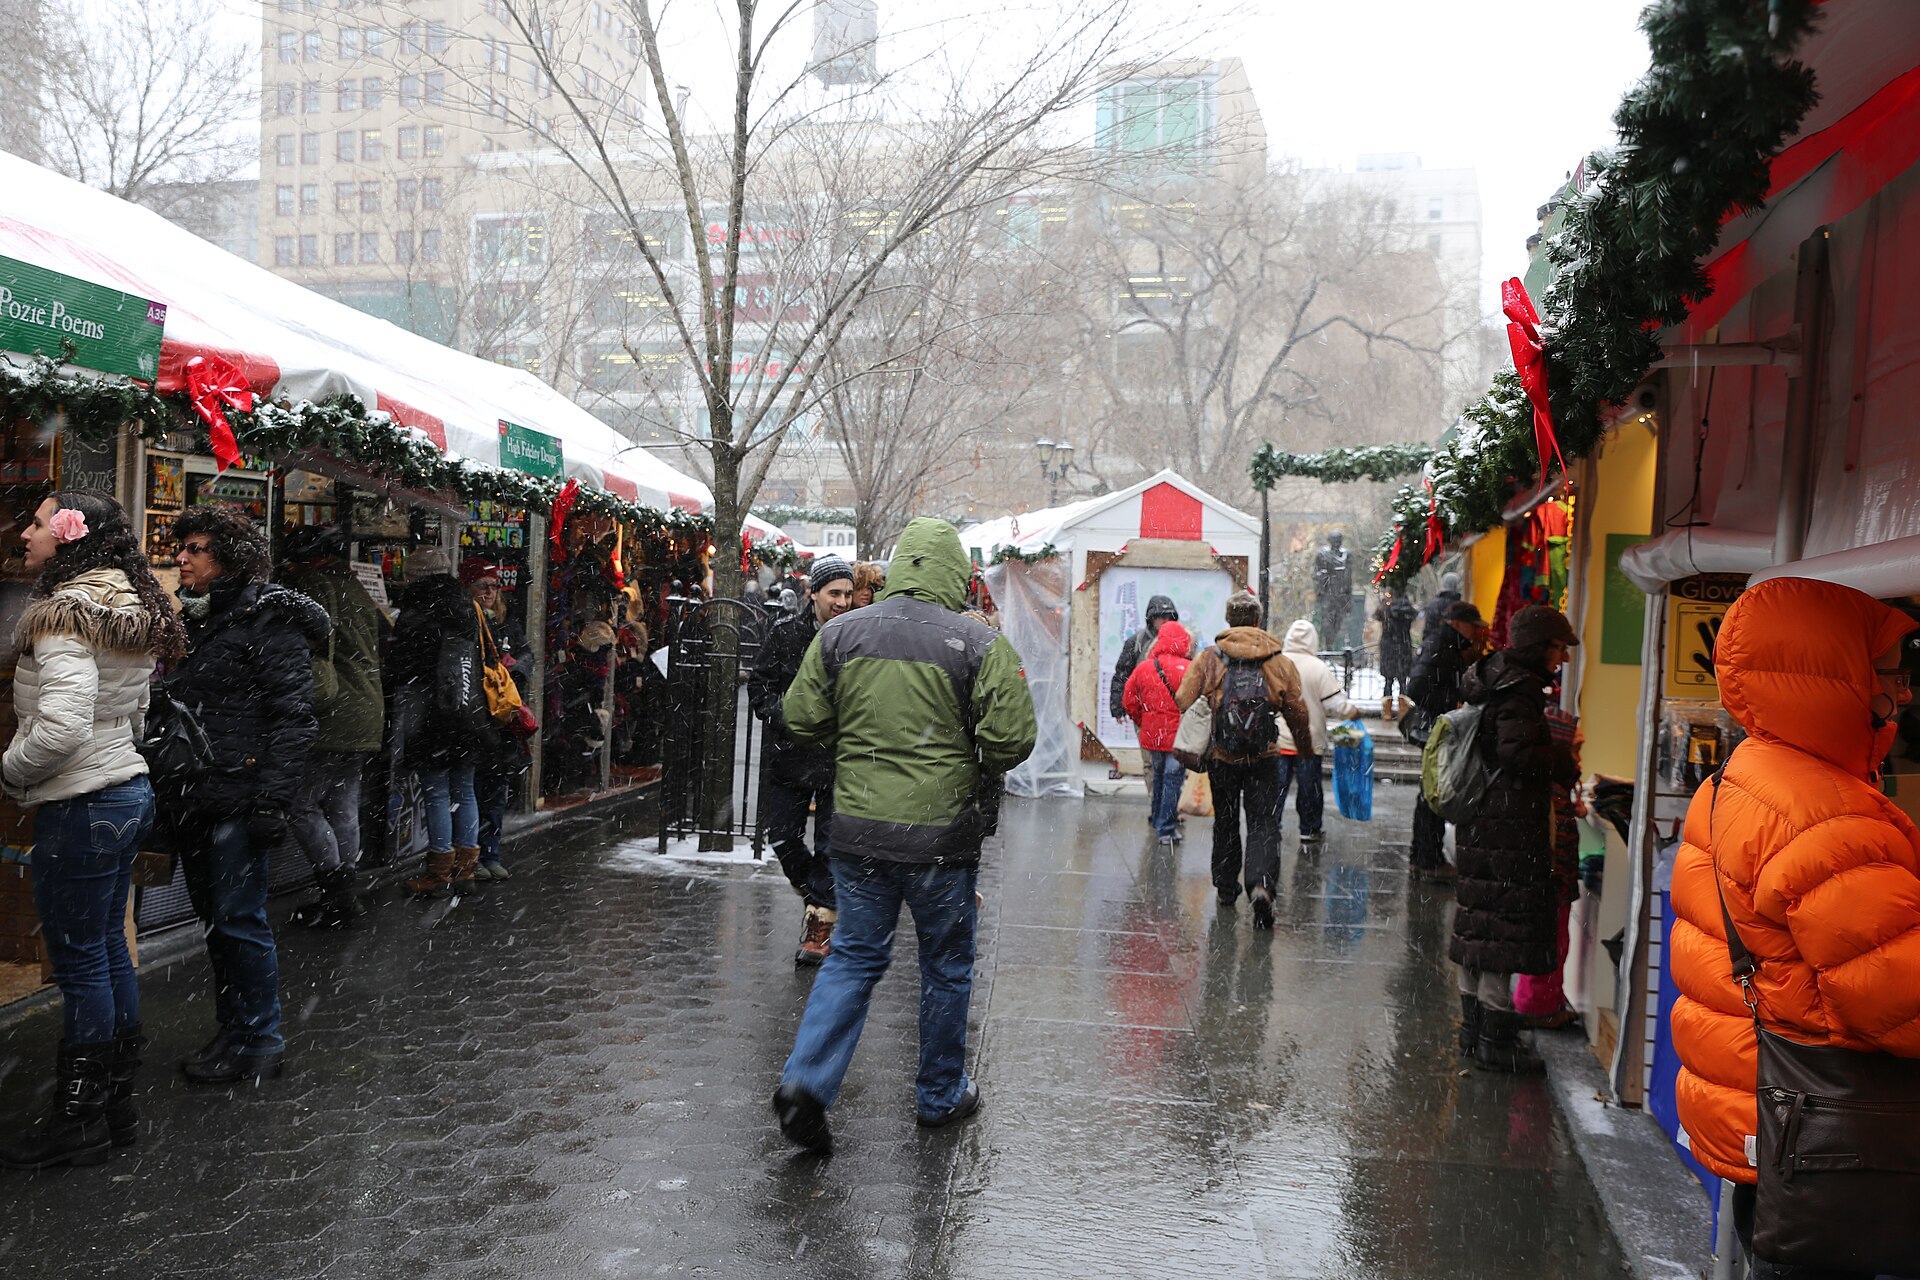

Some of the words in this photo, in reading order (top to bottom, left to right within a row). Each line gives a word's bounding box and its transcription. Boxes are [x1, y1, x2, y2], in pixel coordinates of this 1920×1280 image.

[0, 286, 46, 326] Pozie
[50, 300, 105, 340] Poems
[146, 308, 165, 322] A35
